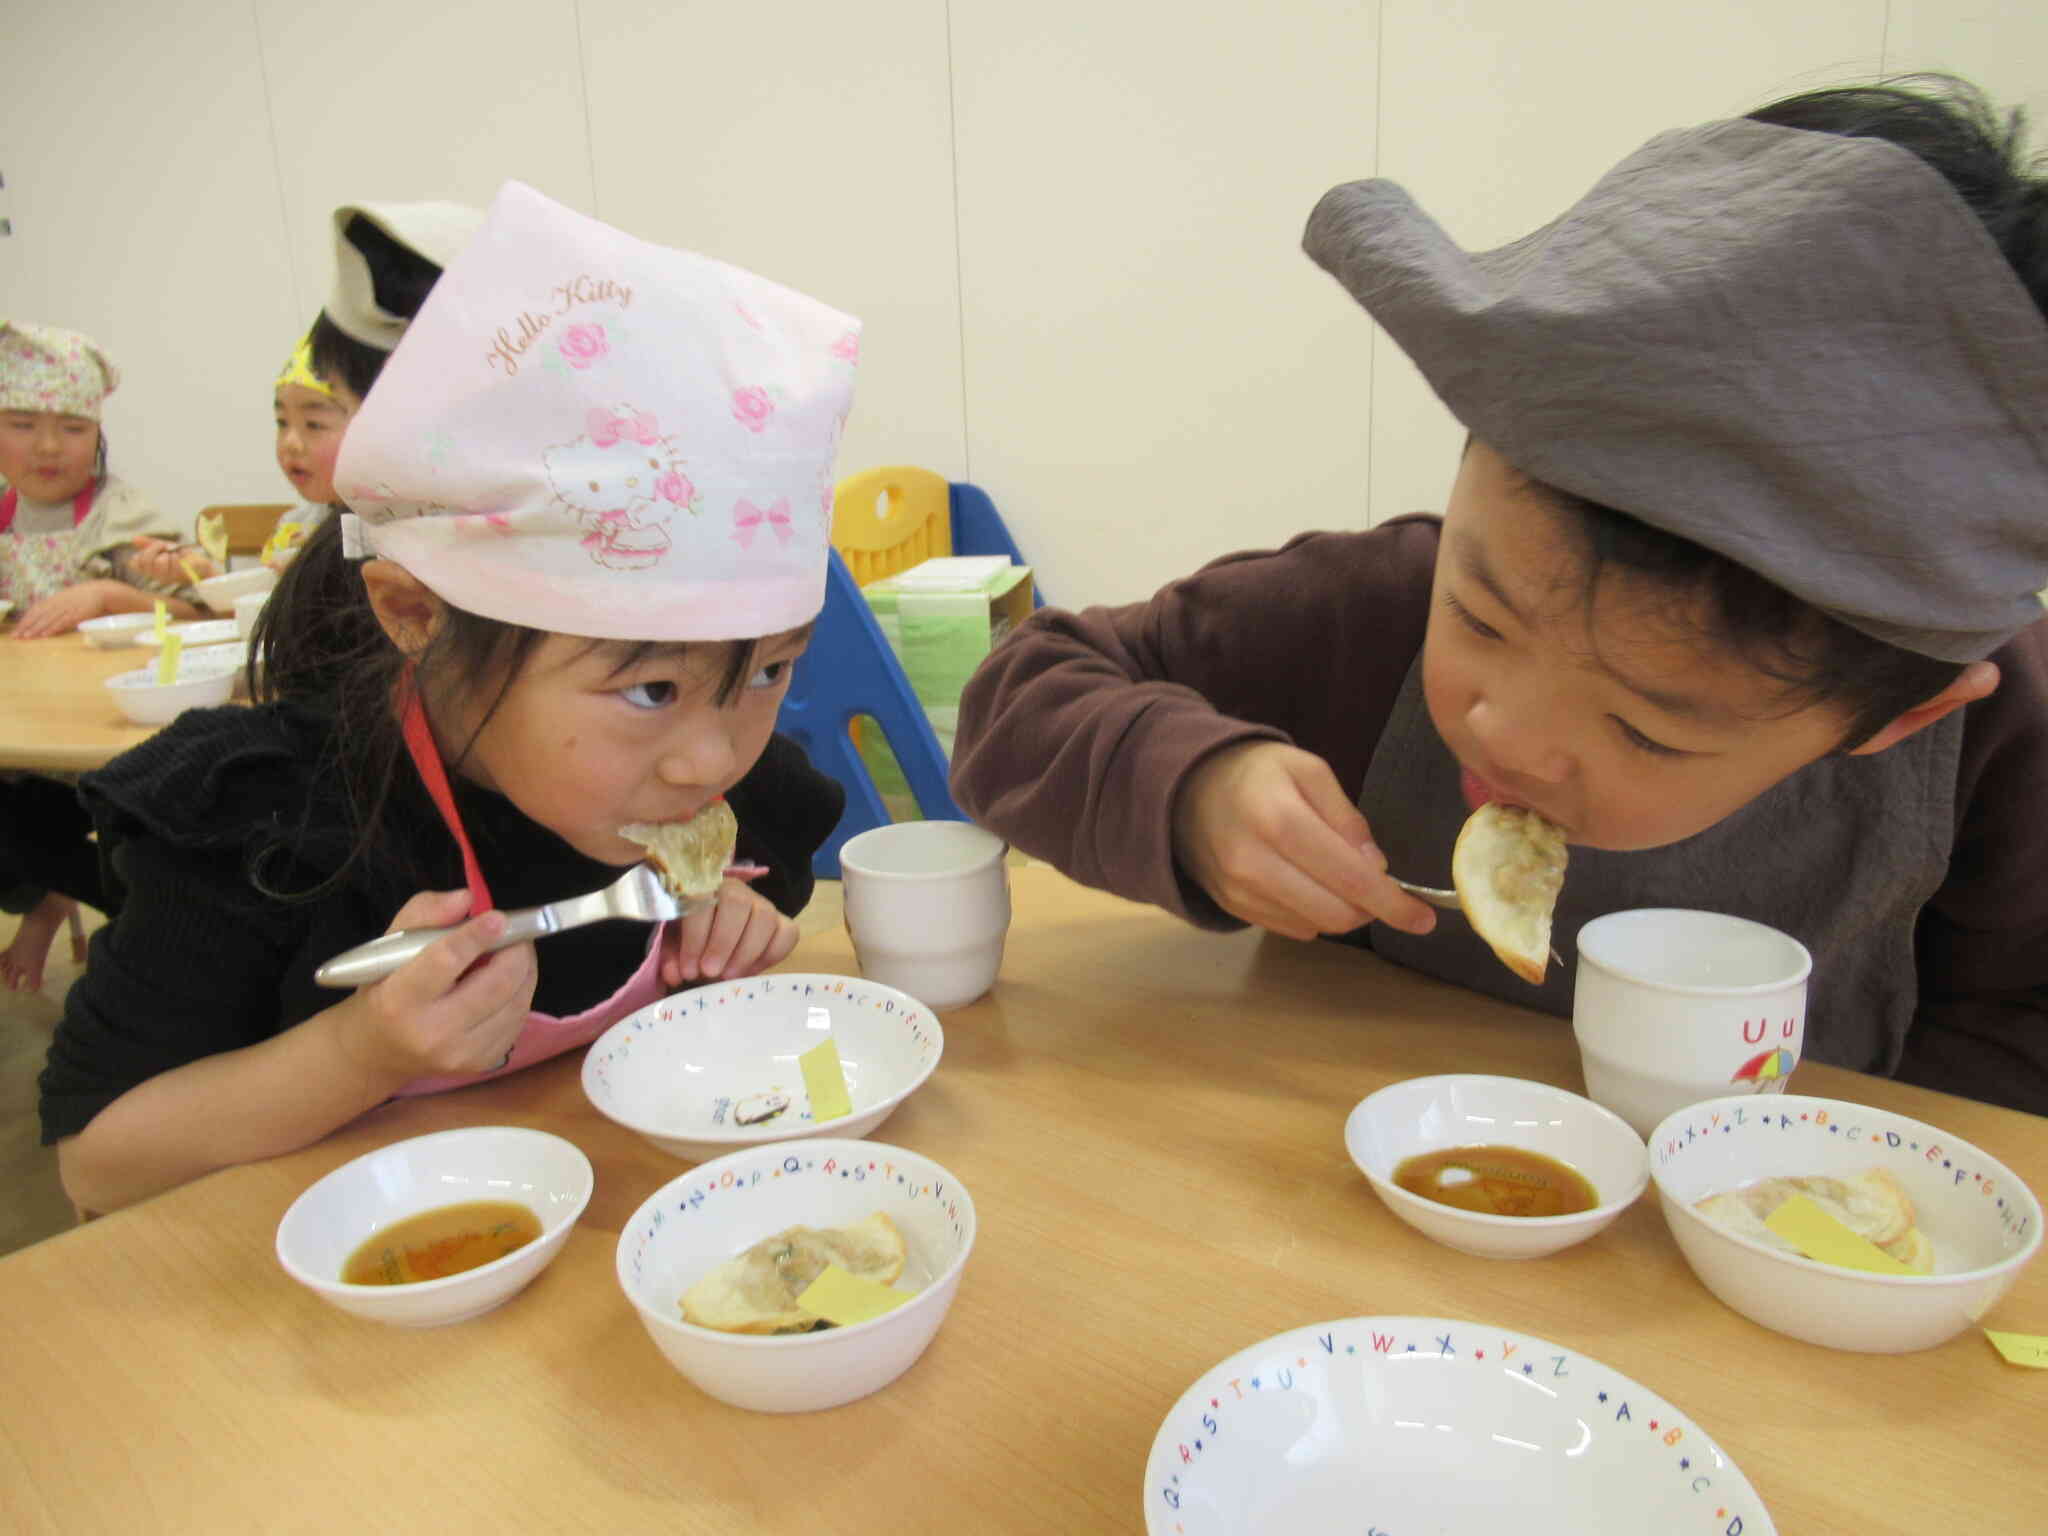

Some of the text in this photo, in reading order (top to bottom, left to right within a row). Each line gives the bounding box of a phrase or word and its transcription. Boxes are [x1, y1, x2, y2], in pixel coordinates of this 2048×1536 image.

[487, 274, 633, 376] Hello Kitty
[720, 1169, 735, 1188] O
[783, 1156, 801, 1173] Q
[1886, 1131, 1901, 1148] D
[1925, 1145, 1943, 1161] E
[1954, 1168, 1967, 1185] F
[1163, 1486, 1180, 1510] Q
[1202, 1413, 1218, 1435] S
[1230, 1378, 1243, 1400] T
[1277, 1367, 1293, 1391] U
[1318, 1332, 1334, 1355] V
[1372, 1331, 1395, 1354] W
[1435, 1332, 1456, 1356] X
[1502, 1340, 1518, 1360] Y
[1551, 1355, 1569, 1377] Z
[1615, 1401, 1631, 1422] A
[1663, 1426, 1683, 1446] B
[1692, 1476, 1711, 1493] C
